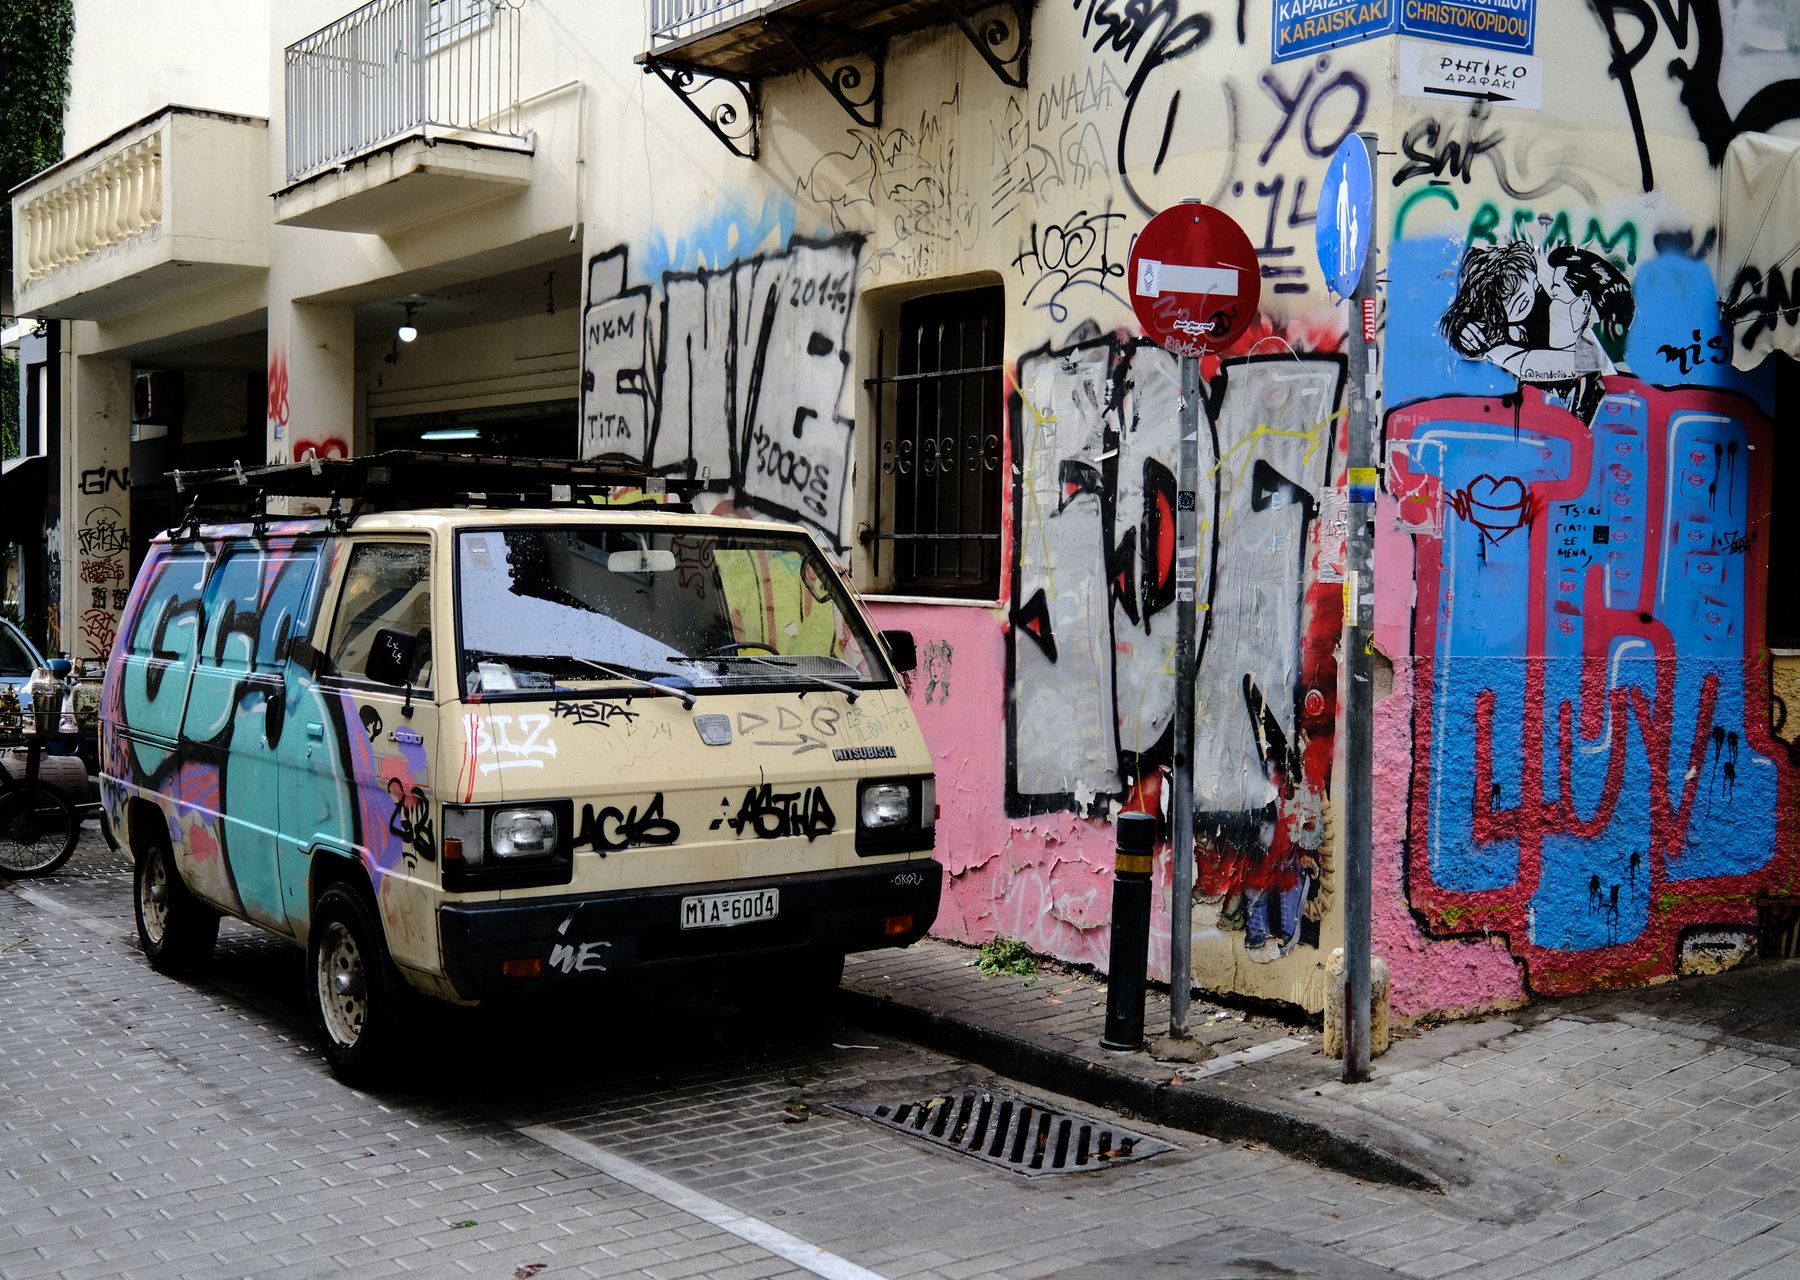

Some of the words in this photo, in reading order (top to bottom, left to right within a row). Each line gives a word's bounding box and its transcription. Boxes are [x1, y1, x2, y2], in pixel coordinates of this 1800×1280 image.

[1280, 0, 1388, 46] KARAISKAKI
[1406, 1, 1528, 37] CHRISTOKOPIDOU
[1445, 73, 1516, 89] ΑΡΑΦΑΚΙ
[832, 746, 897, 761] MITSUBISHI
